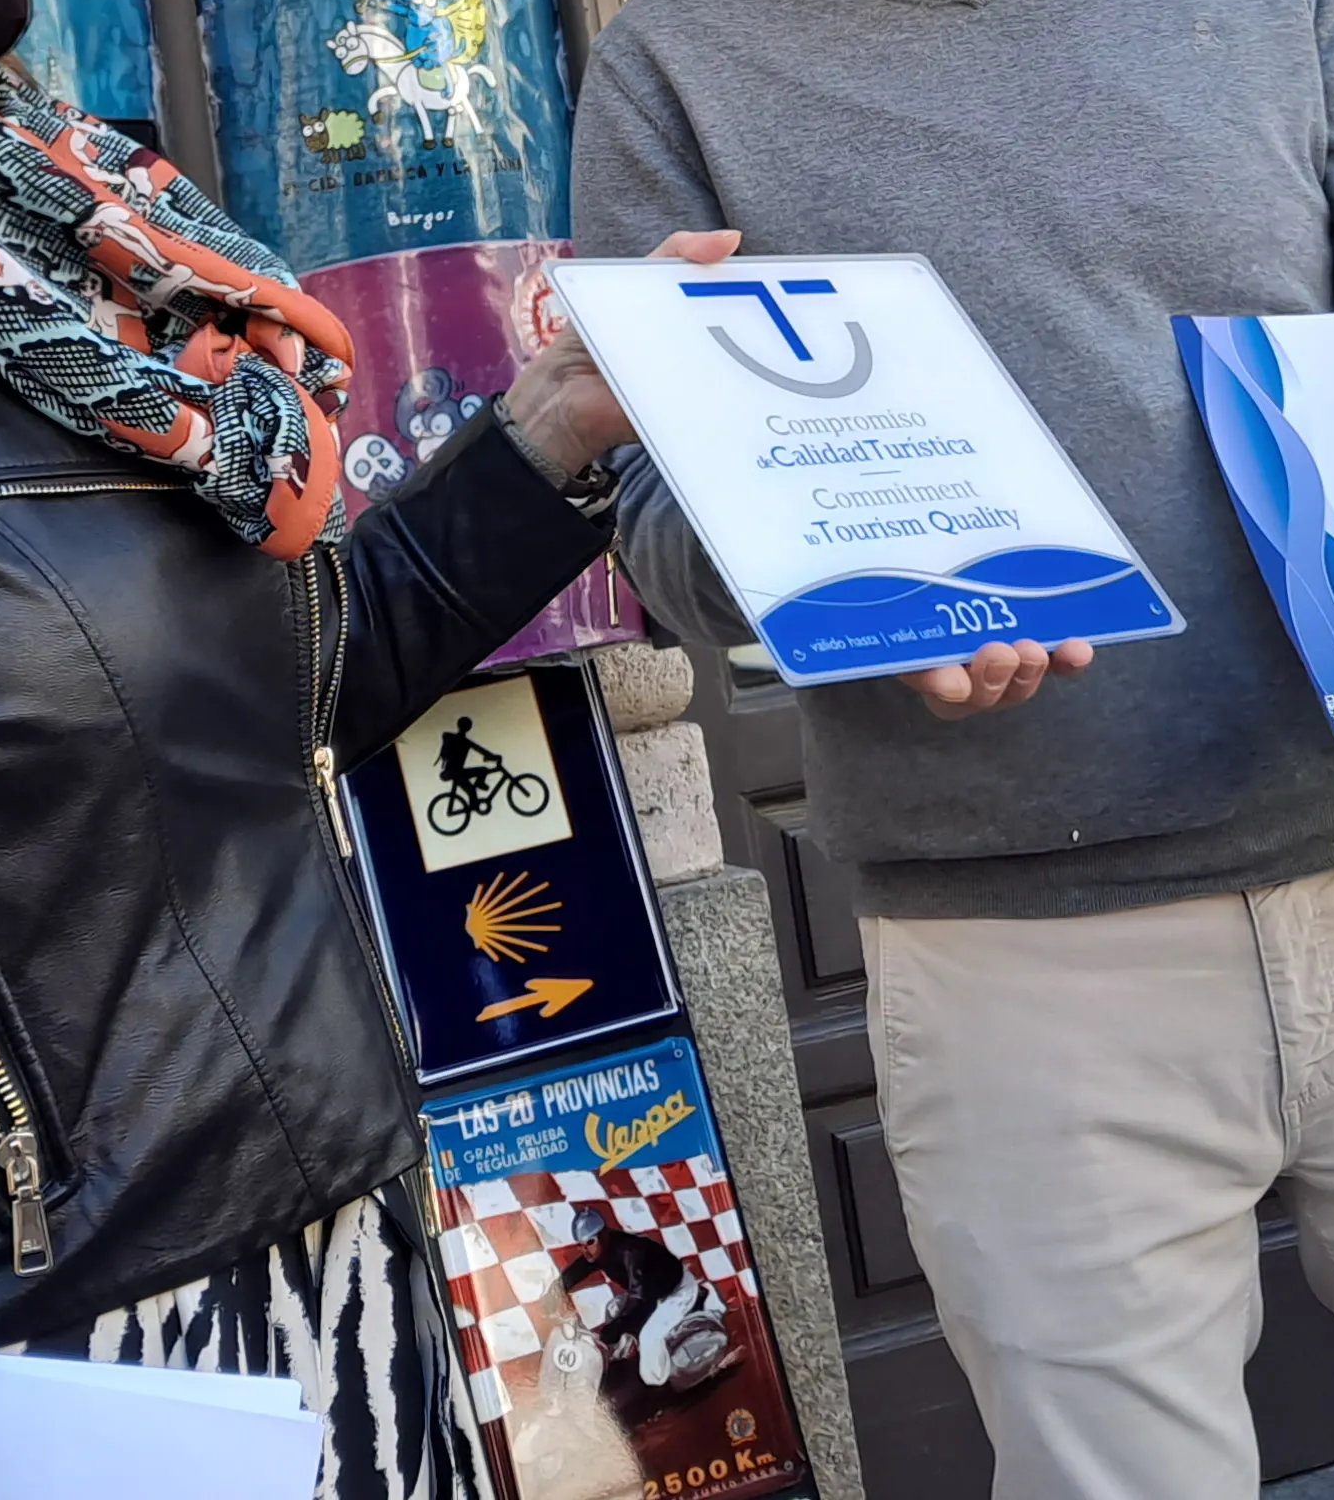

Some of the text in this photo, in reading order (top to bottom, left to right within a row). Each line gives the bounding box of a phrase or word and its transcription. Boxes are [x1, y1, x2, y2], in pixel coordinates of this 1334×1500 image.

[387, 210, 455, 231] Burgos
[766, 409, 927, 437] Compromiso
[756, 455, 775, 469] de
[812, 478, 981, 511] Commitment
[804, 506, 1022, 546] to Tourism Quality
[846, 633, 880, 648] hasta
[890, 626, 919, 643] valid
[935, 596, 1019, 636] 2023
[458, 1059, 661, 1141] LAS 20 PROVINCIAS
[463, 1125, 567, 1164] GRAN PRUEBA
[584, 1089, 697, 1177] Vespa
[445, 1140, 569, 1184] DE REGULARIDAD
[558, 1351, 576, 1367] 60
